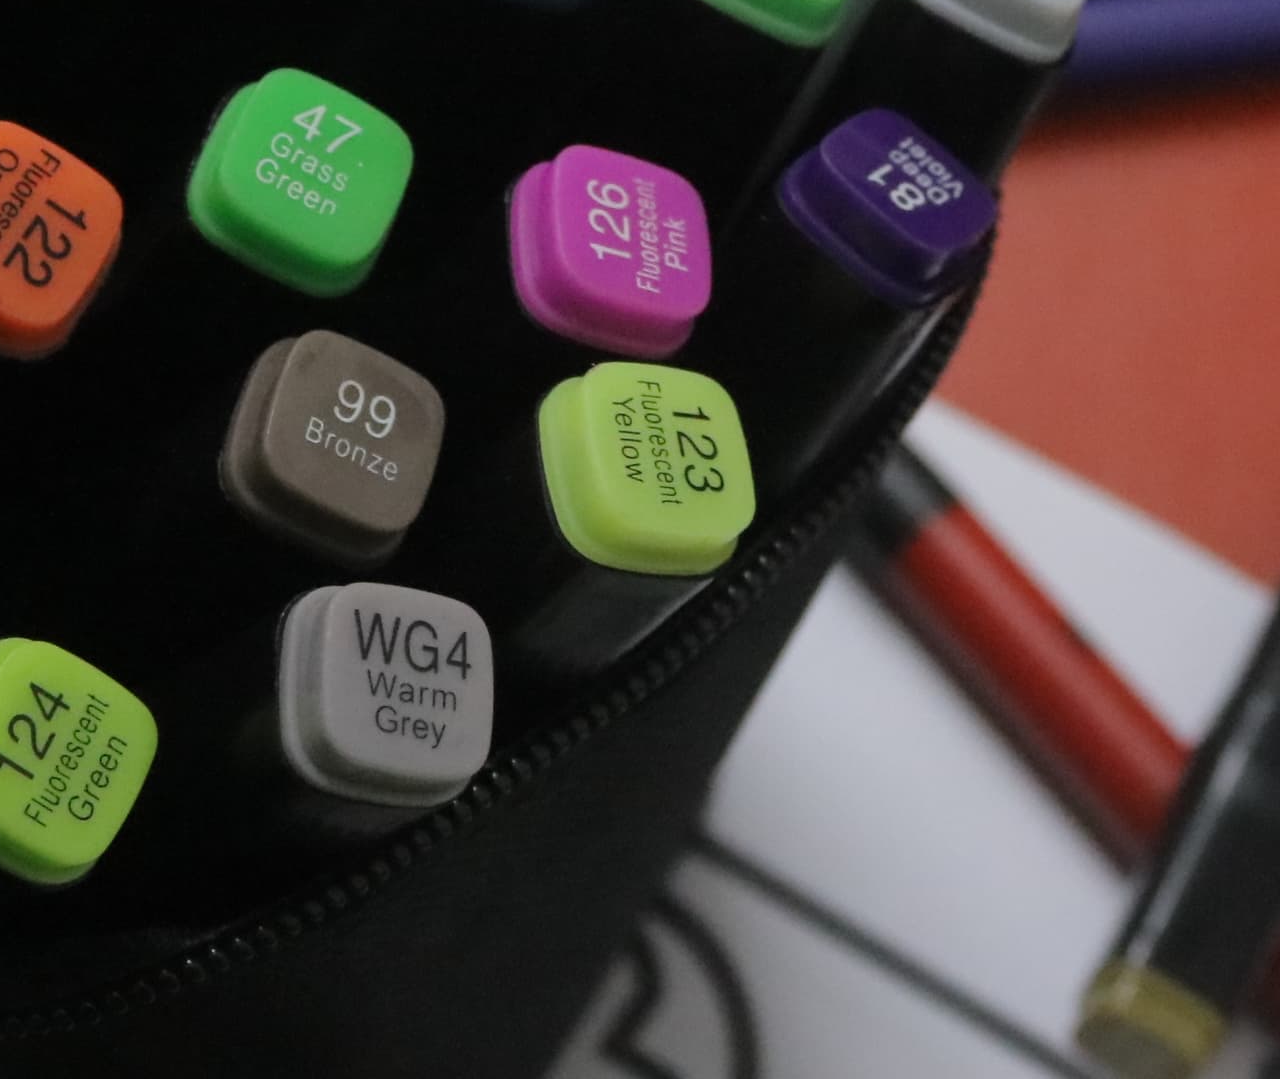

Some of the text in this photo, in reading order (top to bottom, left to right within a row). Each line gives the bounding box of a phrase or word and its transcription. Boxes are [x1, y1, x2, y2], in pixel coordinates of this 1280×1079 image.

[293, 104, 362, 153] 47
[255, 158, 338, 215] Green
[270, 133, 351, 193] Grass
[865, 164, 926, 212] 81
[887, 149, 950, 206] Deep
[899, 136, 964, 200] Violet
[2, 197, 89, 288] 122
[586, 178, 631, 260] 126
[636, 178, 661, 295] Fluorescent
[664, 219, 690, 273] Pink
[333, 379, 398, 440] 99
[611, 395, 645, 484] Yellow
[303, 415, 401, 482] Bronze
[636, 379, 684, 506] Fluorescent
[672, 405, 725, 495] 123
[352, 607, 473, 681] WG4
[366, 668, 459, 712] Warm
[374, 704, 447, 749] Grey
[22, 691, 111, 829] Fluorescent
[66, 734, 129, 822] Green
